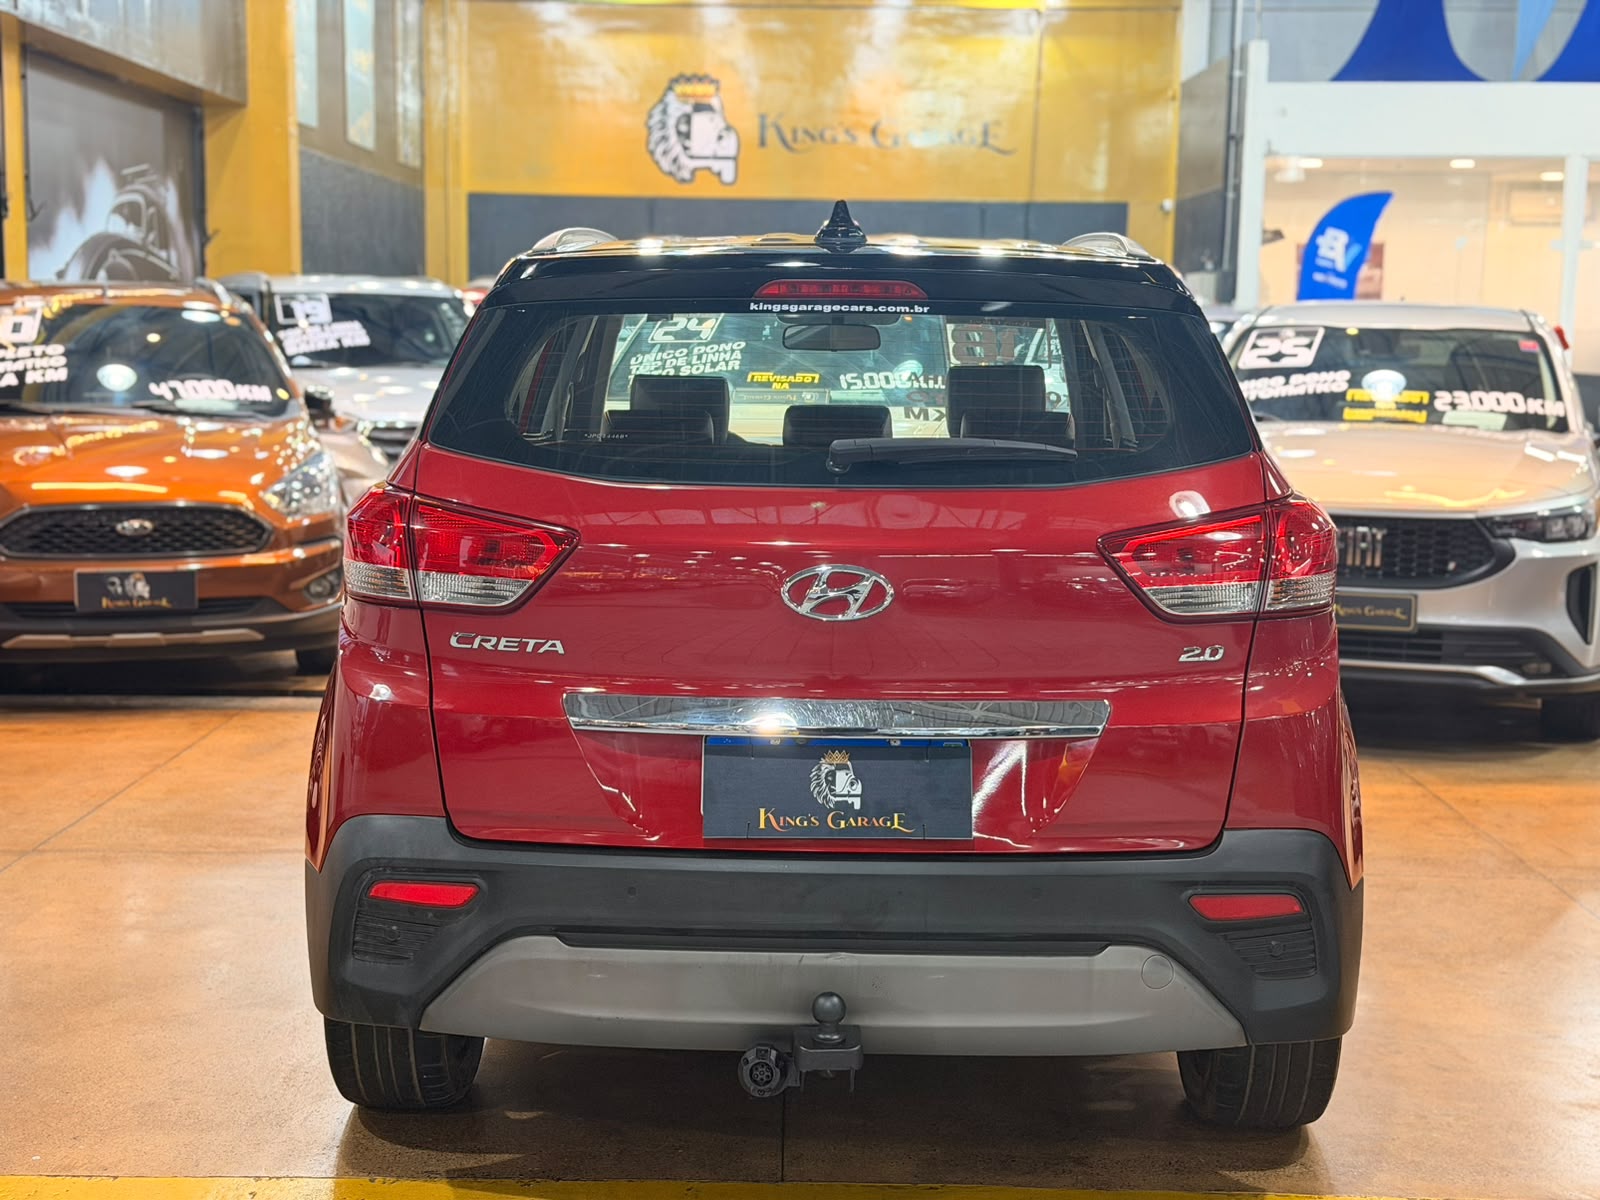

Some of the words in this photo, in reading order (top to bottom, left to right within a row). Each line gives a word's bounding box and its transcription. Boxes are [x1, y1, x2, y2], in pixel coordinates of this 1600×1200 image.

[750, 302, 930, 313] kingsgaragecars.com.br
[654, 317, 716, 340] 24
[665, 357, 688, 368] DE
[692, 350, 742, 364] LINHA
[680, 360, 741, 376] SOLAR
[772, 382, 790, 390] NA
[450, 632, 565, 654] CRETA
[758, 807, 820, 832] KING'S
[827, 810, 916, 833] GARAGE
